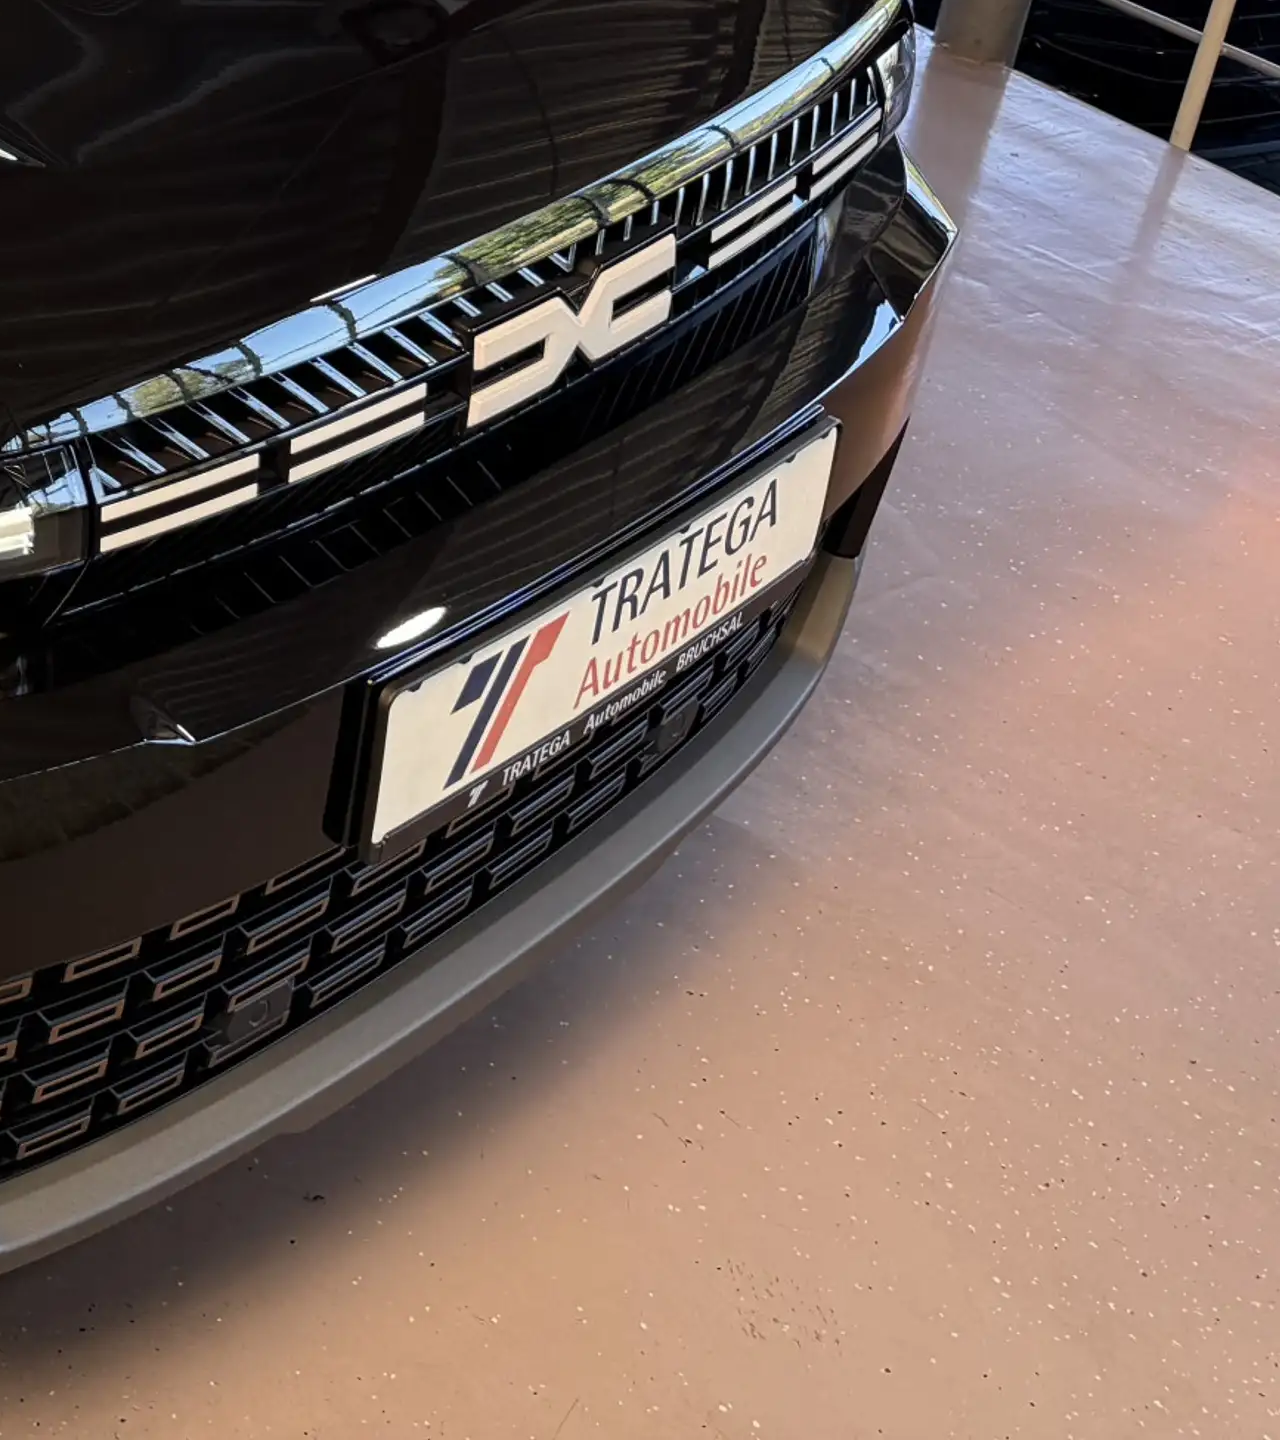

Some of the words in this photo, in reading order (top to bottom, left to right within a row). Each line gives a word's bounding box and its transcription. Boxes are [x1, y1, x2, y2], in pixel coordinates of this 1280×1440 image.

[573, 553, 768, 710] Automobile
[591, 478, 778, 645] TRATEGA
[502, 730, 572, 786] TRATEGA
[583, 670, 667, 734] Automobile
[676, 612, 743, 672] BRUCHSAL
